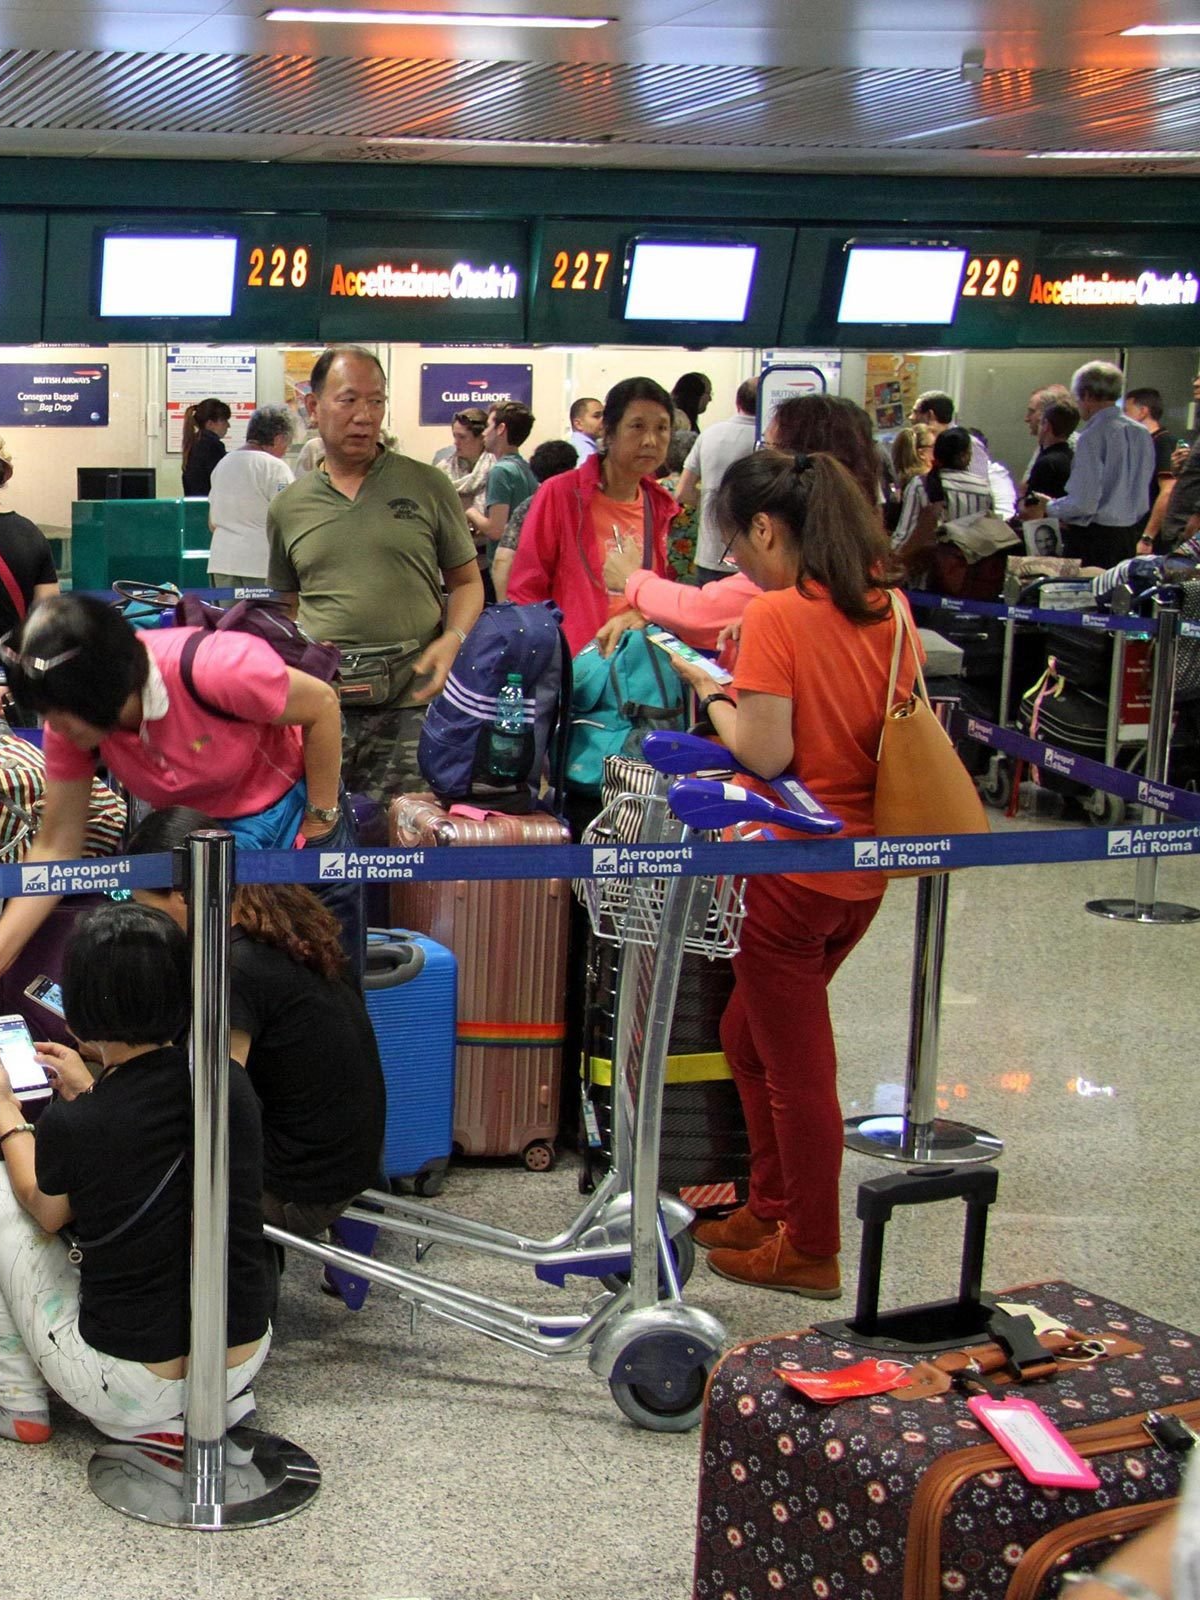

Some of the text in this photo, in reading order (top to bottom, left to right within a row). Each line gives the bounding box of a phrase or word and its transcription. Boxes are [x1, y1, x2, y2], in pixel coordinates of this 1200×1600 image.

[247, 248, 308, 287] 228
[552, 251, 610, 290] 227
[330, 262, 450, 298] Accettazione
[962, 258, 1020, 297] 226
[1029, 272, 1137, 305] Accettazione
[33, 376, 91, 384] BRITISH AIRWAYS
[17, 391, 79, 402] Consegna Bagagli
[441, 391, 512, 402] CLUB EUROPE
[54, 403, 72, 412] Drop
[880, 839, 950, 854] Aeroporti
[1133, 841, 1192, 854] di Roma
[347, 851, 424, 867] Aeroporti
[620, 847, 692, 862] Aeroporti
[880, 854, 940, 866] di Roma
[51, 860, 130, 878] Aeroporti
[322, 868, 343, 877] ADR
[347, 866, 412, 879] di Roma
[595, 864, 615, 872] ADR
[619, 861, 681, 873] di Roma
[24, 882, 46, 891] ADR
[51, 877, 118, 891] di Roma
